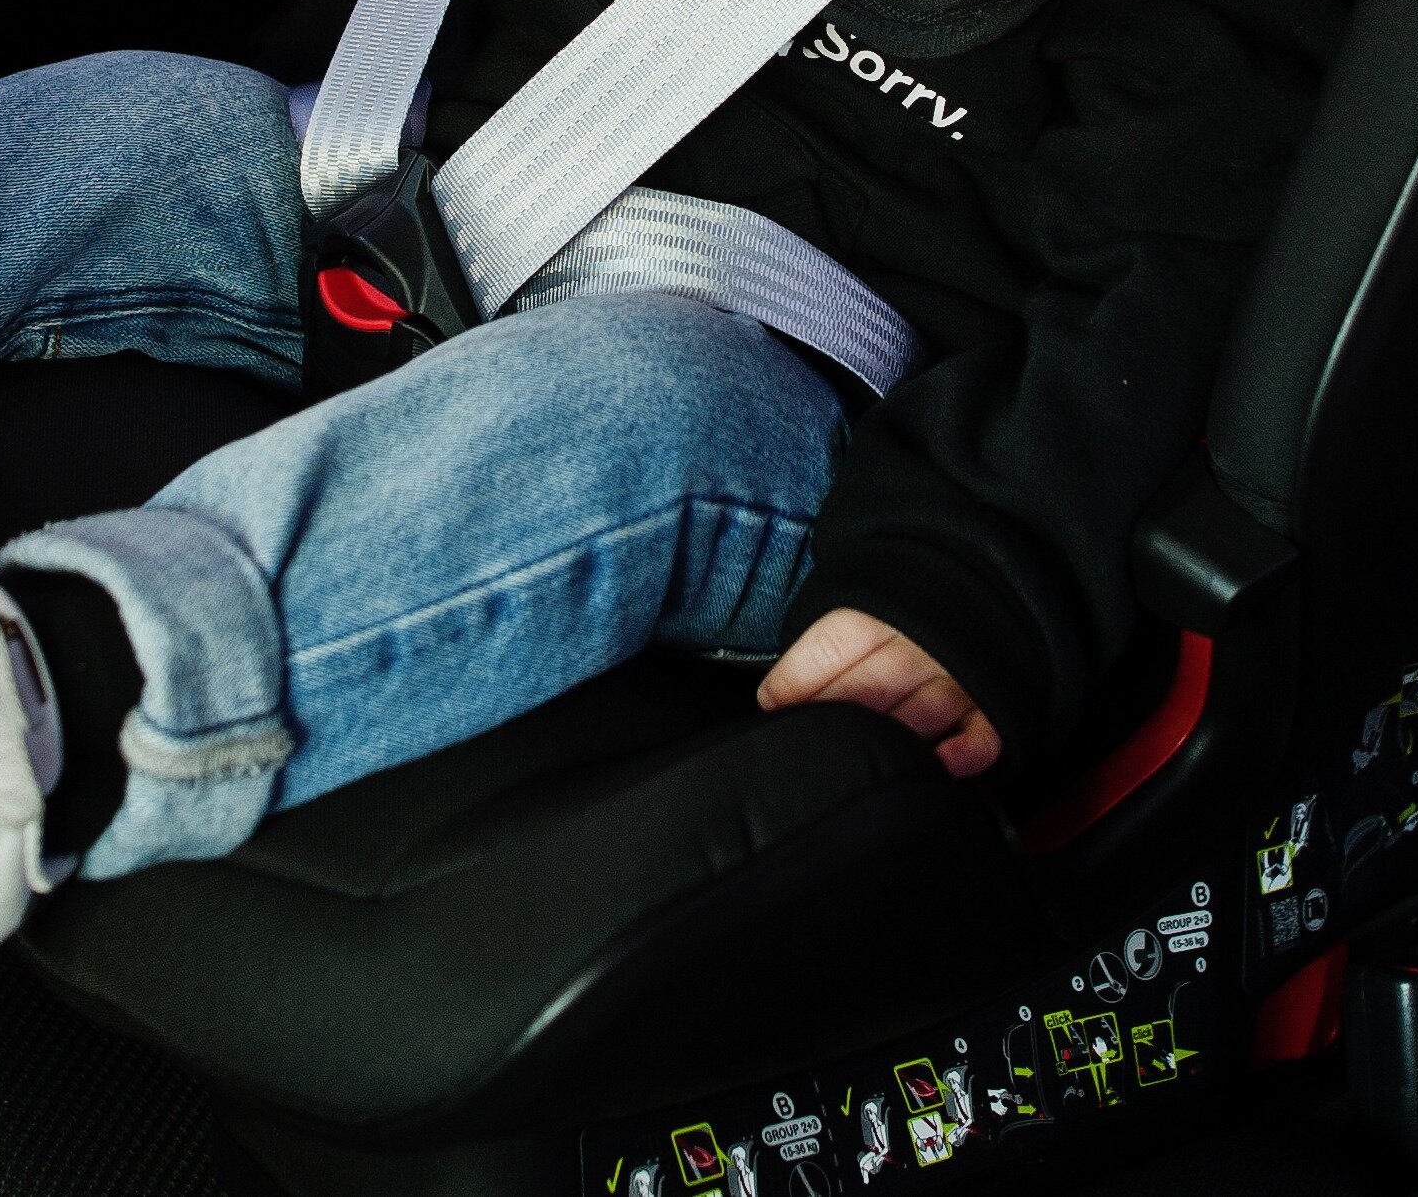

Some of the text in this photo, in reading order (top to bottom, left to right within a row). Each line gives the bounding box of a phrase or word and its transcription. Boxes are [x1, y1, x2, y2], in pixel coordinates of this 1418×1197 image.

[1195, 886, 1208, 904] B
[1160, 914, 1210, 932] GROUP 2+3
[1195, 936, 1205, 946] kg
[1046, 1012, 1070, 1027] click
[776, 1096, 792, 1115] B
[764, 1118, 819, 1142] GROUP 2+3
[807, 1141, 818, 1153] kg
